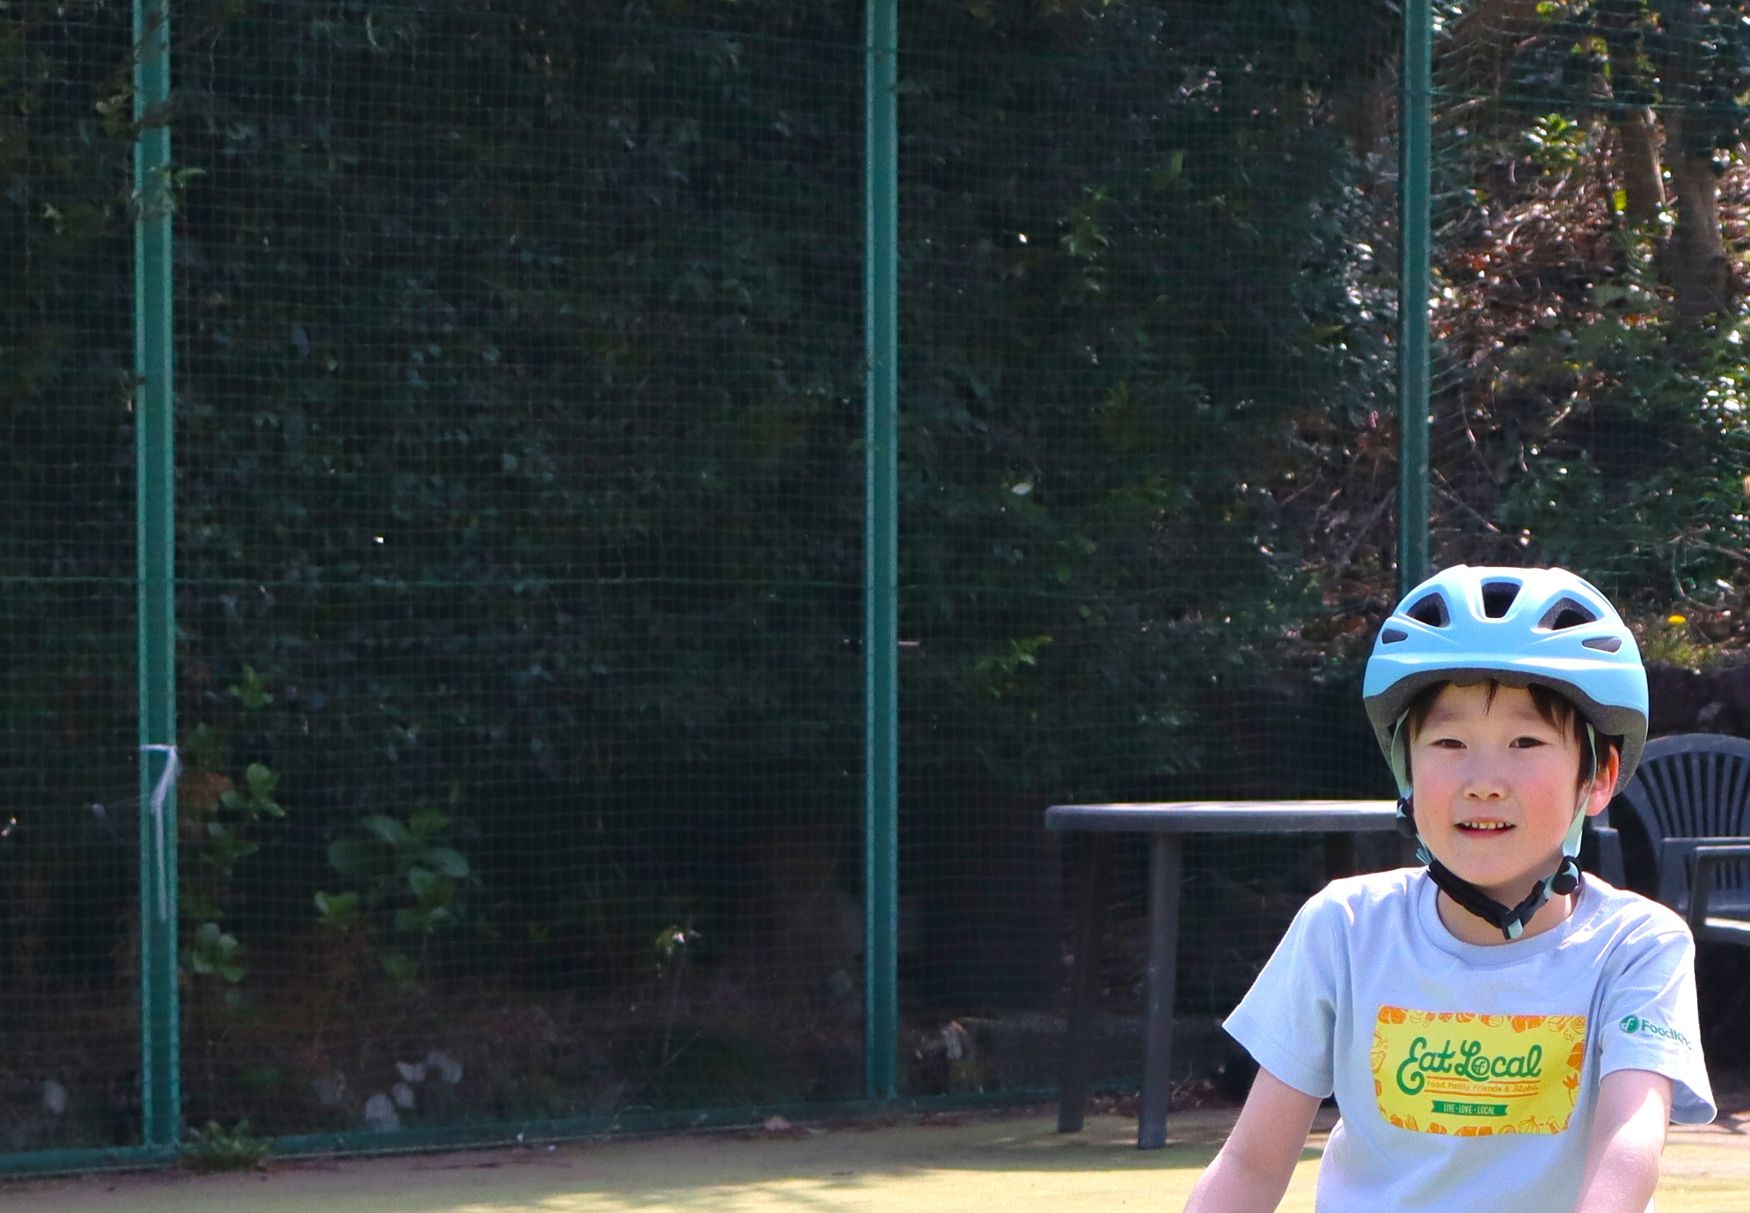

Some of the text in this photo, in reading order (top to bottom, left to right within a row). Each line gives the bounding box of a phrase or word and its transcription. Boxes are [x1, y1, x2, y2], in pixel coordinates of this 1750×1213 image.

[1396, 1036, 1543, 1096] Eat Local
[1443, 1103, 1496, 1115] LIVE LOVE LOCAL
